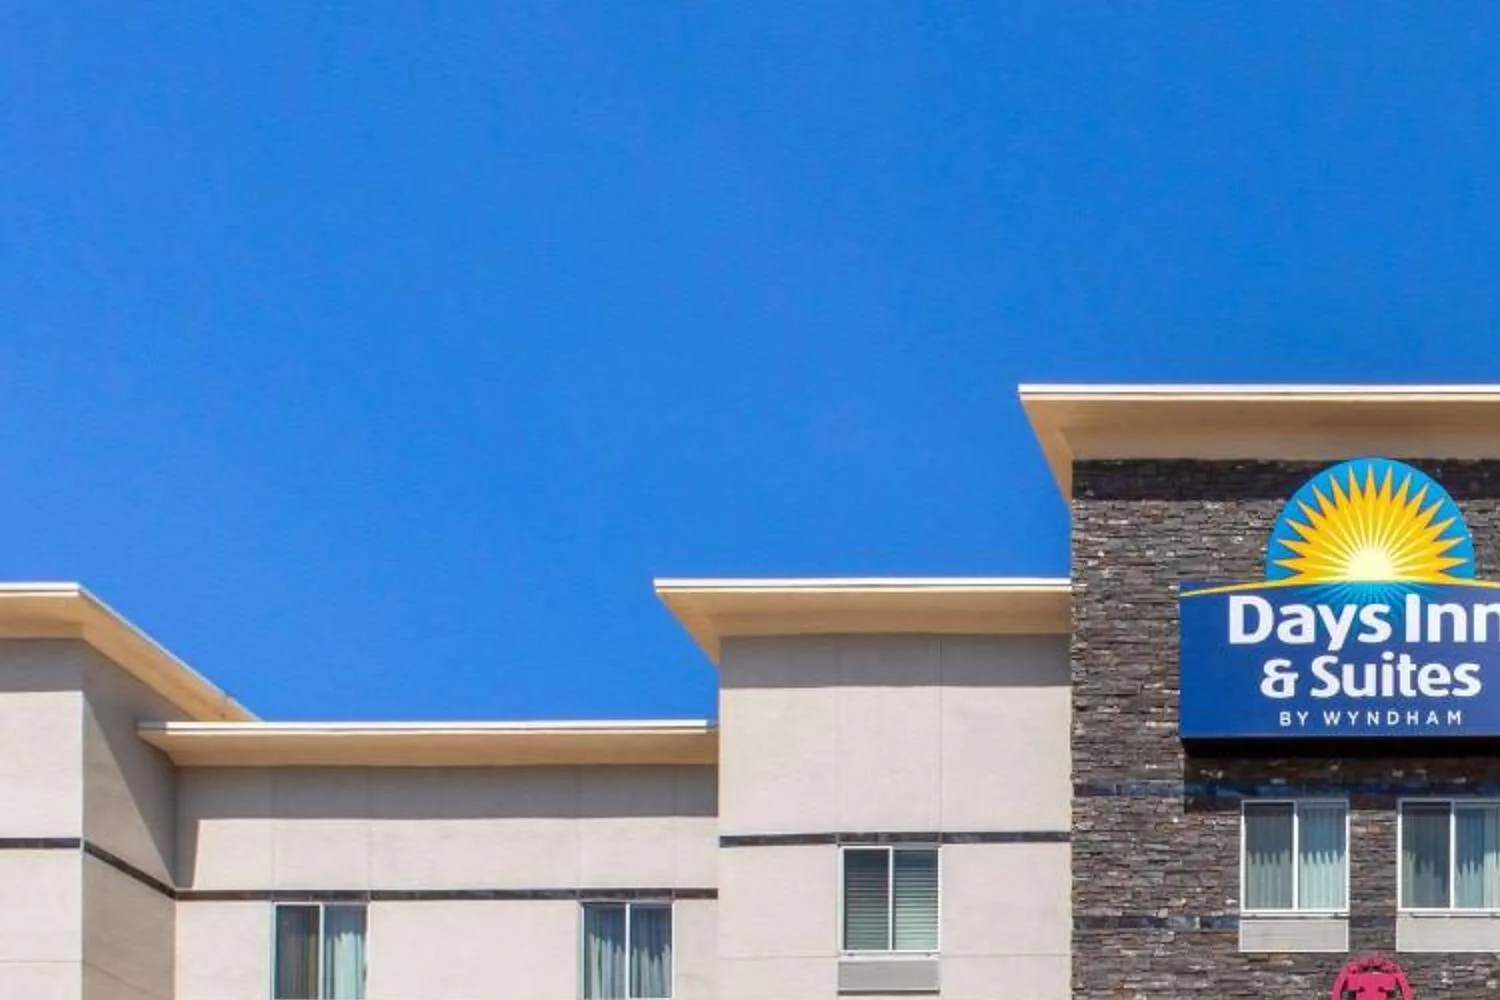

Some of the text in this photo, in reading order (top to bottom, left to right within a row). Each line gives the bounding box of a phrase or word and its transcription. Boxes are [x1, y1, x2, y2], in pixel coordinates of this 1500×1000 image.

[1228, 595, 1392, 651] Days
[1260, 651, 1482, 699] & Suites
[1279, 710, 1462, 727] BY WYNDHAM
